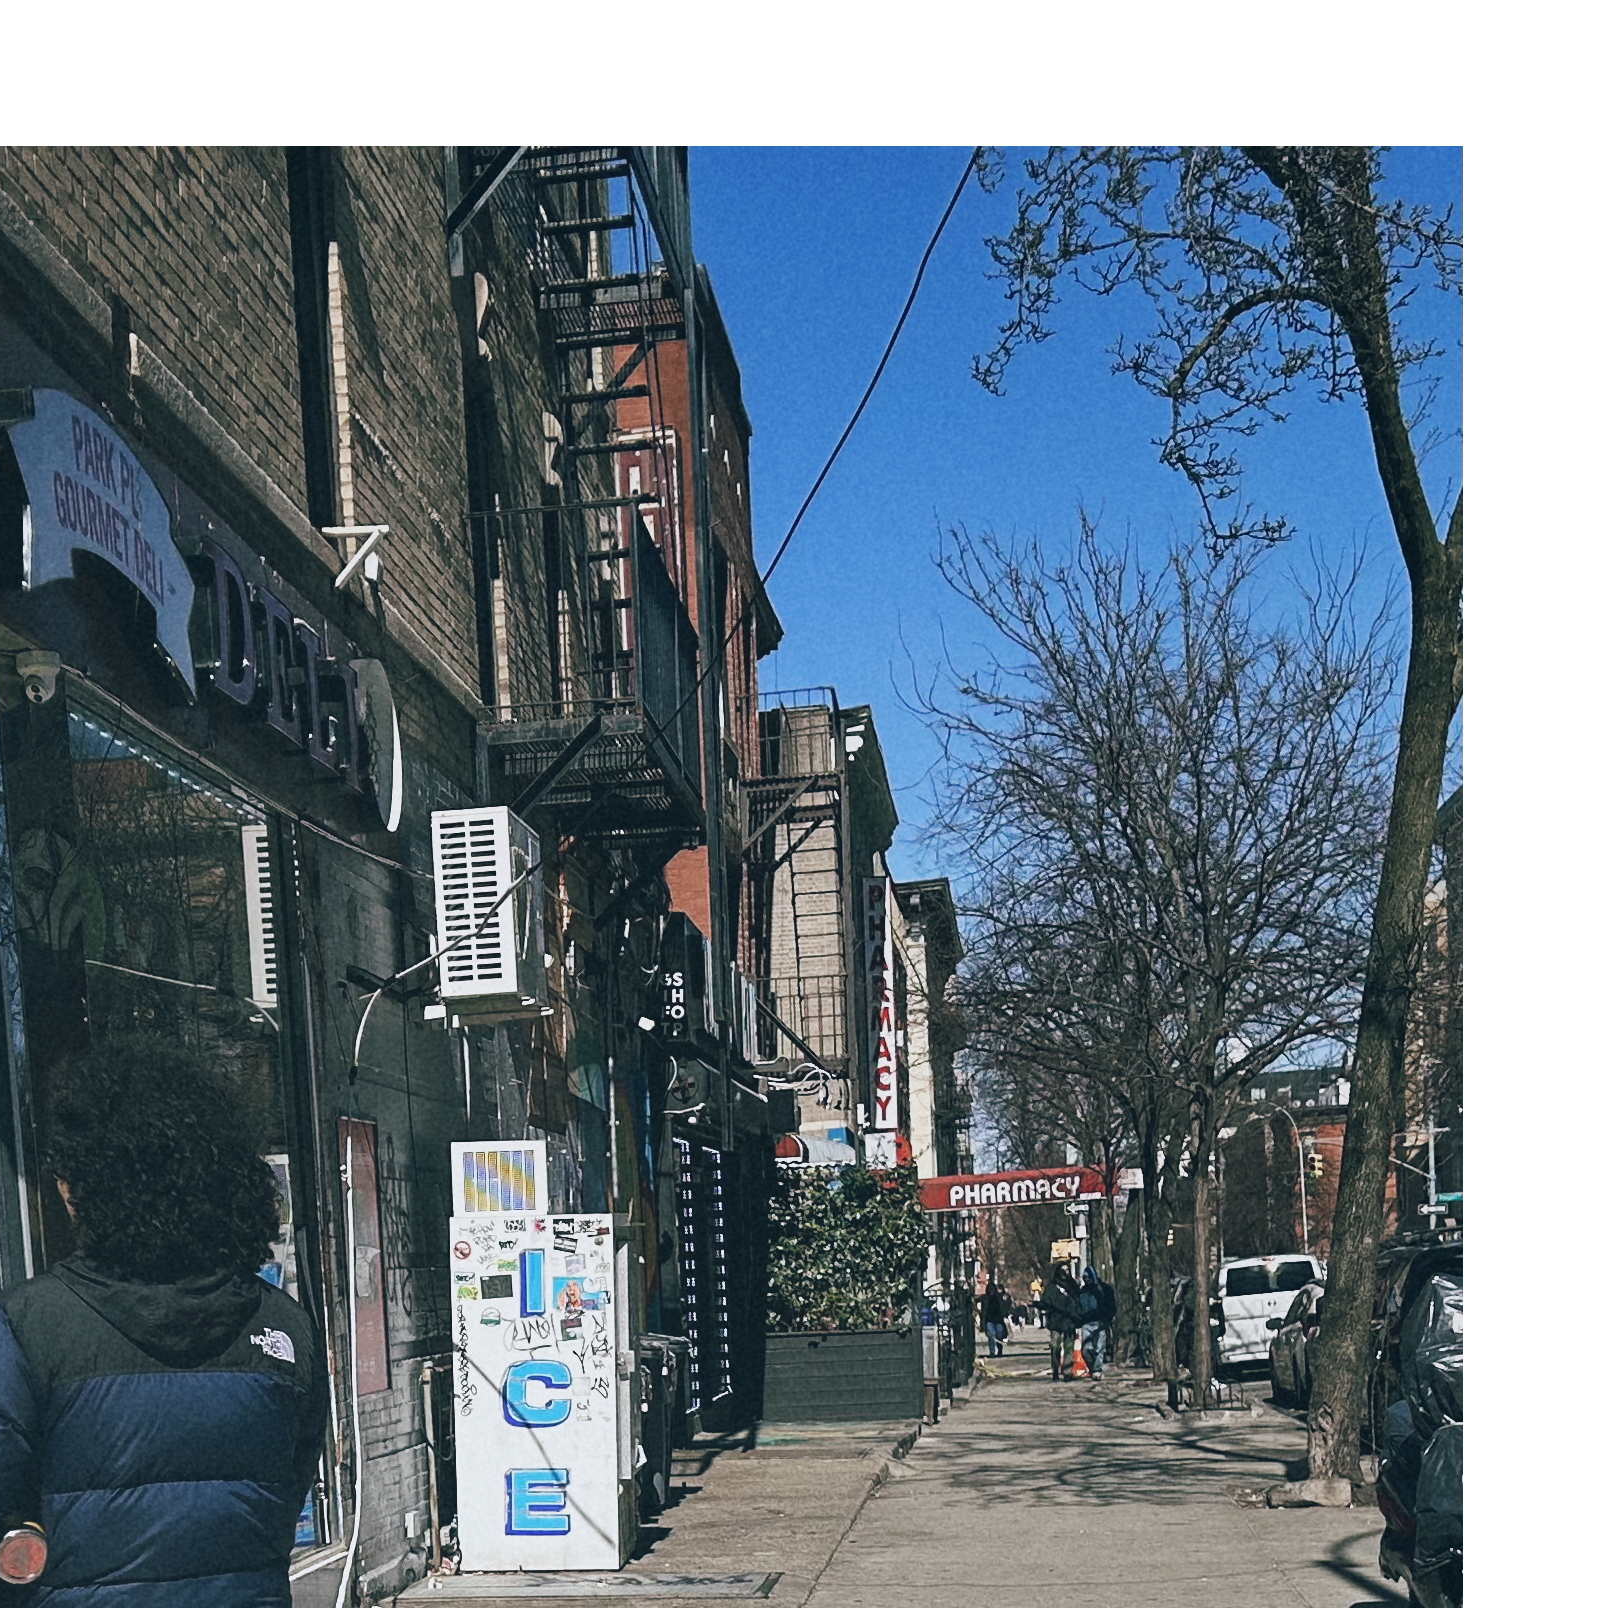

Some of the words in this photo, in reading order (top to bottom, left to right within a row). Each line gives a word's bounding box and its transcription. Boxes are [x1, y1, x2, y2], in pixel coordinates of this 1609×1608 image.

[71, 414, 118, 497] PARK
[53, 470, 131, 568] GOURMET
[134, 527, 165, 608] DELI
[201, 536, 365, 795] DELI
[671, 971, 685, 1037] SHOP
[867, 883, 892, 1122] PHARMACY
[949, 1174, 1081, 1207] PHARMACY
[501, 1248, 573, 1537] ICE
